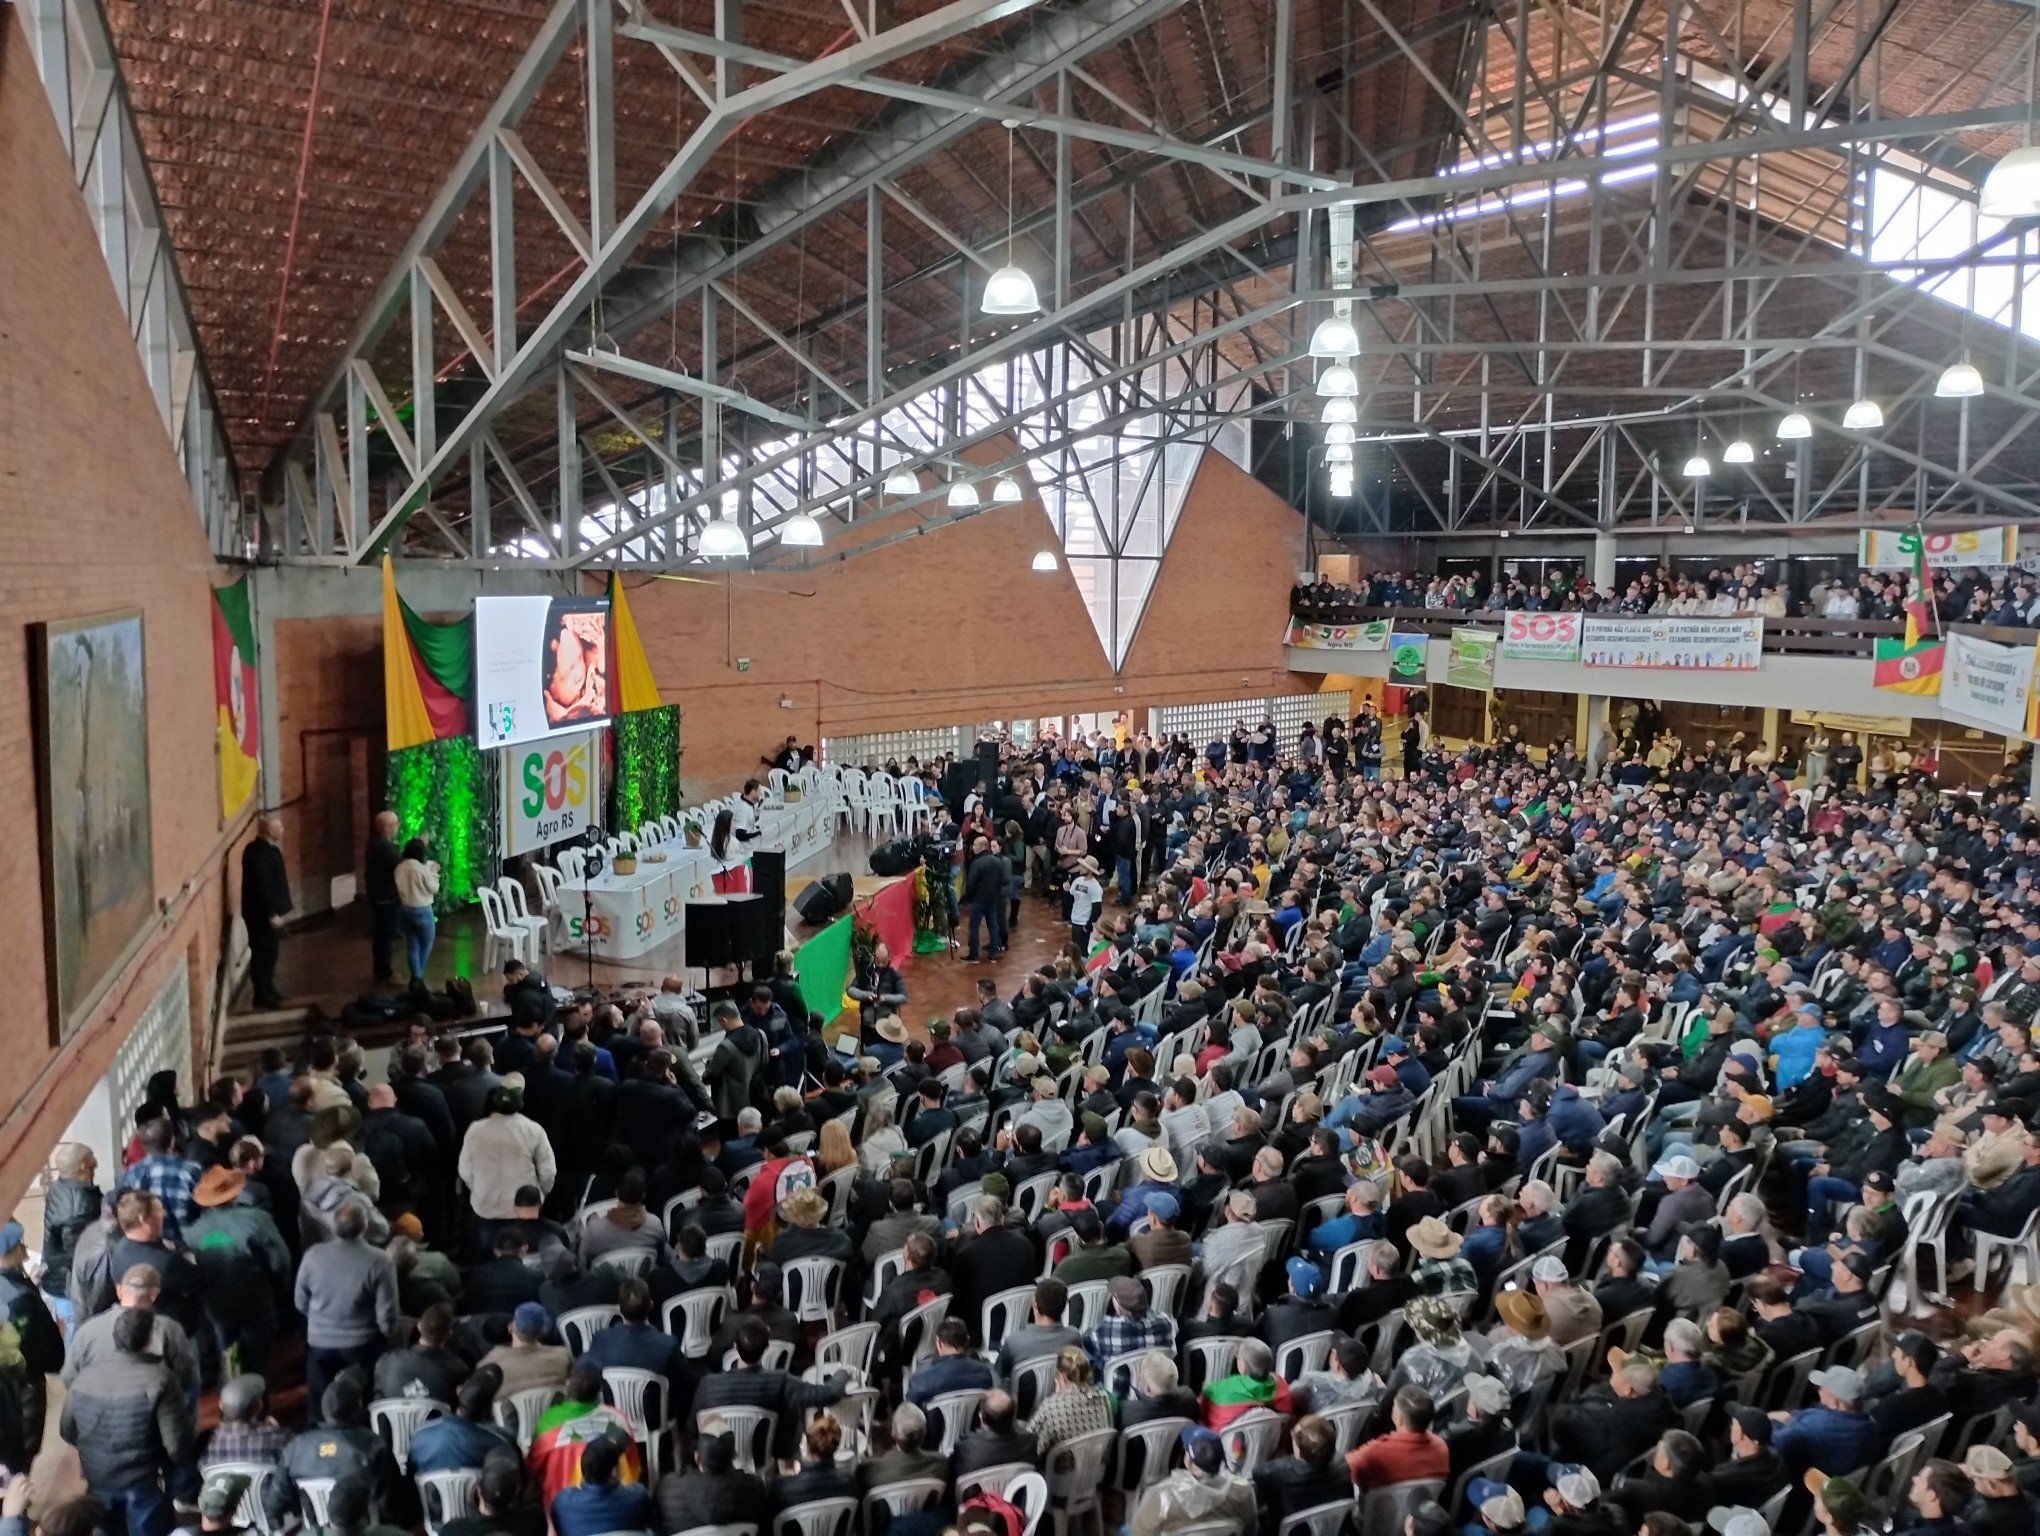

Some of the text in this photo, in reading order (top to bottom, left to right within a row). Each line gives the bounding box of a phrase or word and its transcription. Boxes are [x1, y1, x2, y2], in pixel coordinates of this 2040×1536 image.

[1897, 530, 1979, 553] SOS
[1942, 555, 1958, 563] RS
[1508, 613, 1576, 643] SOS
[523, 744, 587, 818] SOS
[536, 811, 574, 840] Agro RS
[570, 915, 613, 938] SOS
